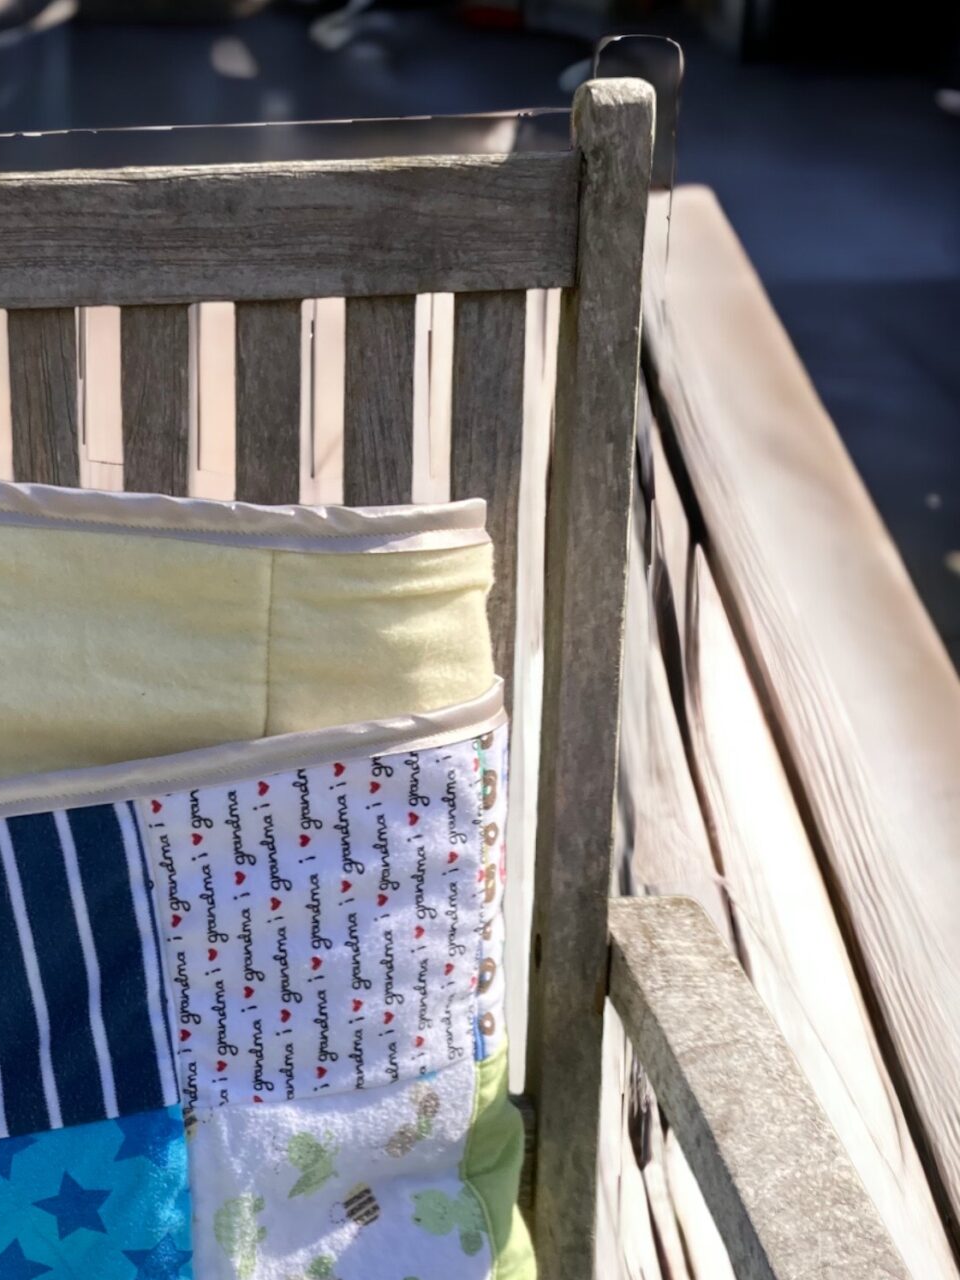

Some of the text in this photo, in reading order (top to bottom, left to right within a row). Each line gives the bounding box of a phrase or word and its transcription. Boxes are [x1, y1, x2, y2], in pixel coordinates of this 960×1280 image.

[224, 790, 258, 866] grandma
[333, 794, 365, 875] grandma
[441, 770, 467, 845] grandma
[158, 834, 191, 912] grandma
[259, 814, 293, 892] grandma
[372, 814, 400, 891] grandma
[410, 845, 438, 920] grandma
[198, 864, 229, 943] grandma
[305, 873, 333, 950] grandma
[445, 881, 466, 957] grandma
[237, 907, 266, 982] grandma
[272, 926, 303, 1004] grandma
[344, 912, 372, 990] grandma
[379, 929, 405, 1006] grandma
[173, 951, 201, 1025] grandma
[210, 980, 239, 1056] grandma
[313, 989, 339, 1062] grandma
[412, 958, 432, 1031] grandma
[248, 1019, 275, 1092] grandma
